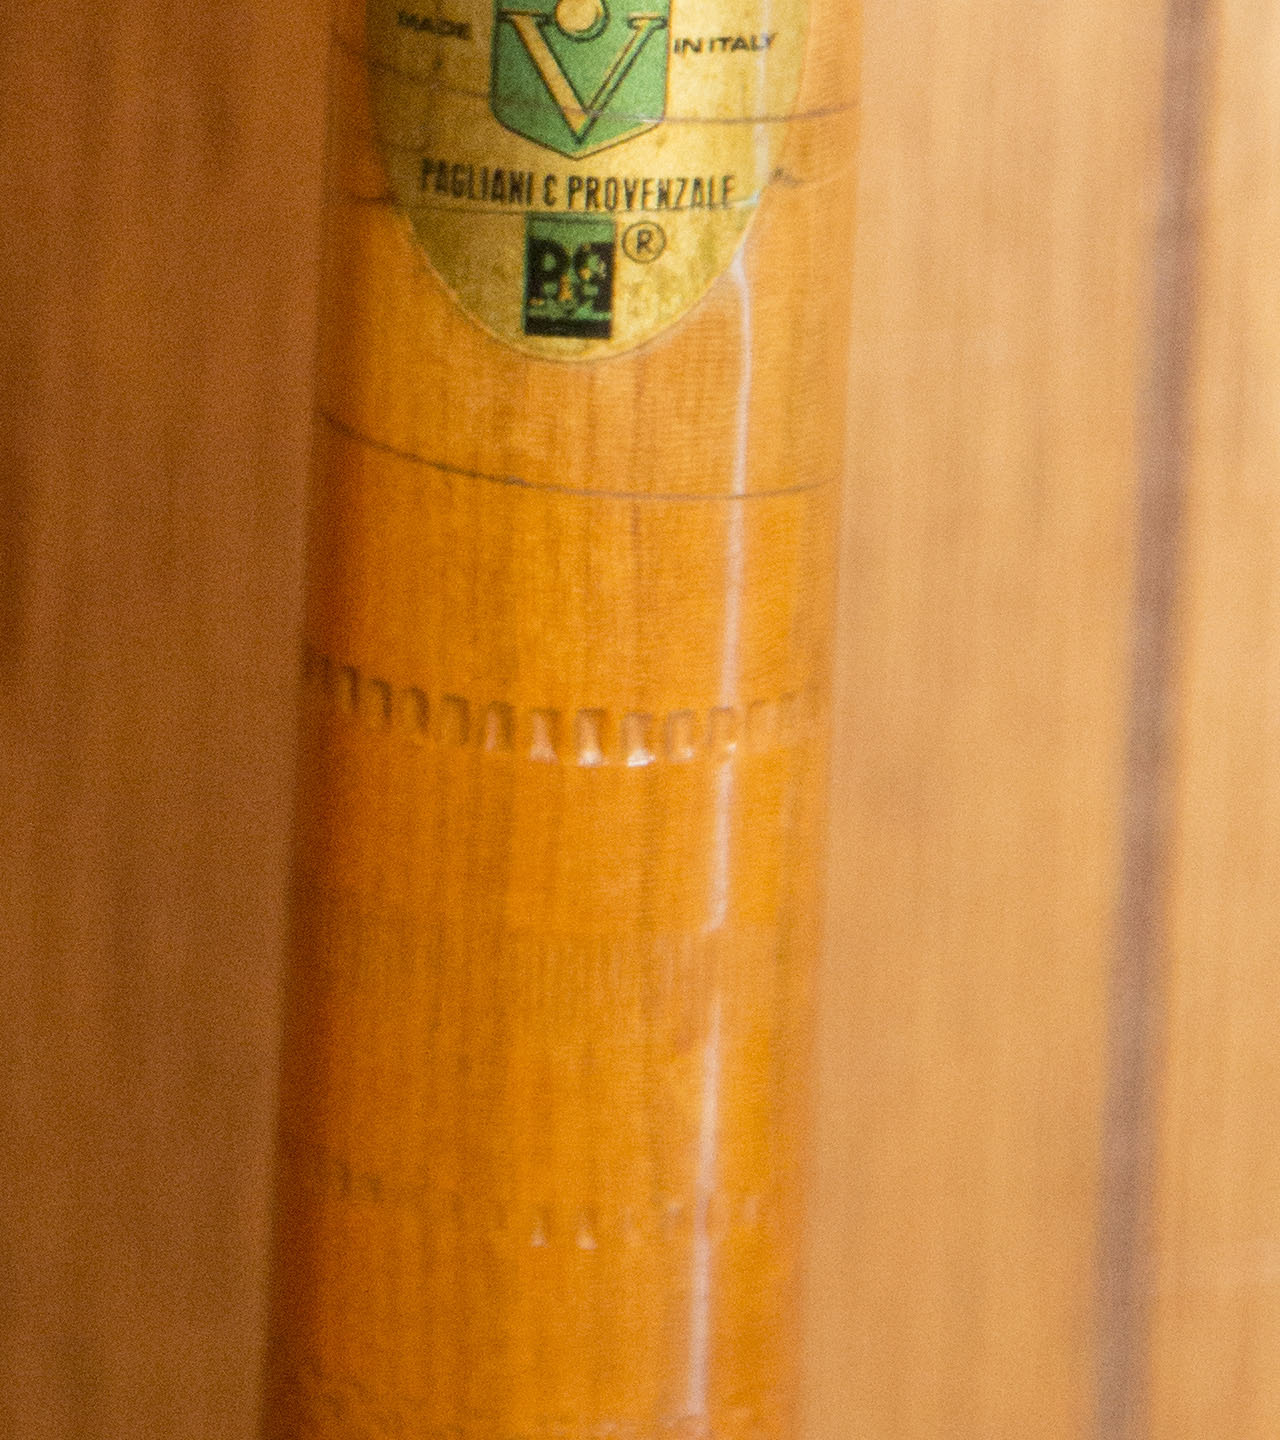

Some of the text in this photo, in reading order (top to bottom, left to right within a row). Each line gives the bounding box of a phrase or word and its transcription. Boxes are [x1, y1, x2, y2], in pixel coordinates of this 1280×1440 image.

[397, 9, 779, 55] MADE IN ITALY
[420, 156, 534, 206] PAGLIANI
[567, 173, 736, 212] PROVENZALE
